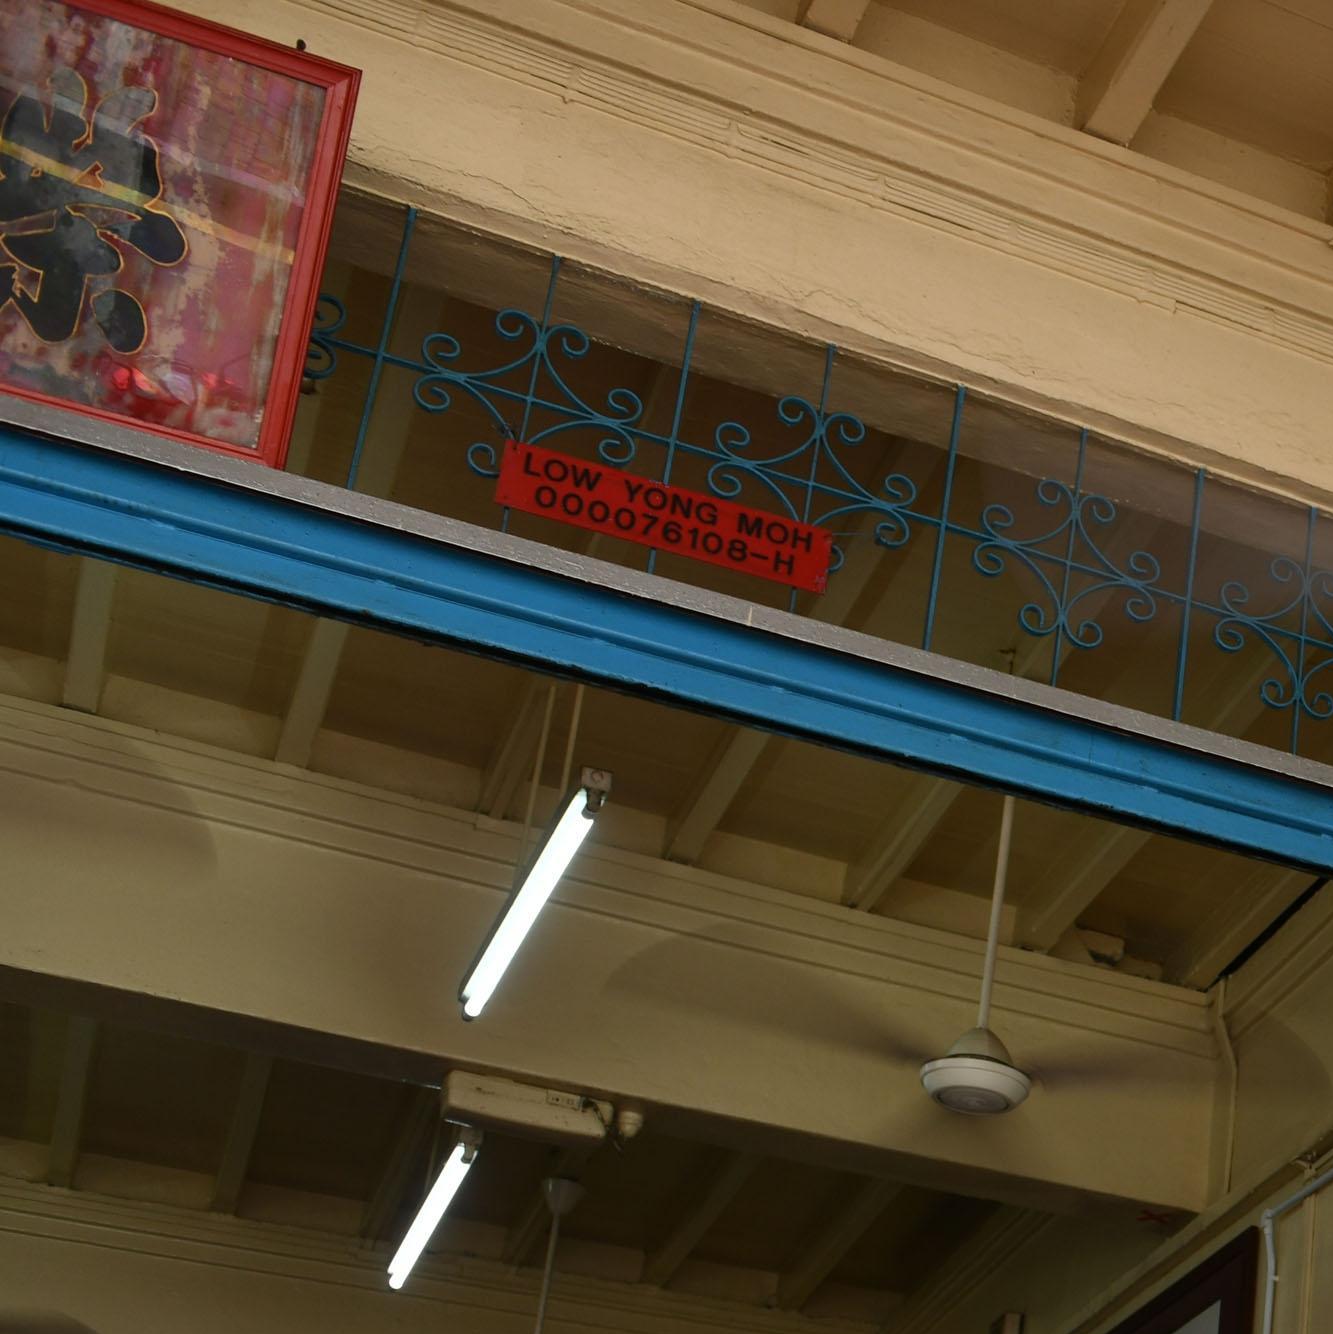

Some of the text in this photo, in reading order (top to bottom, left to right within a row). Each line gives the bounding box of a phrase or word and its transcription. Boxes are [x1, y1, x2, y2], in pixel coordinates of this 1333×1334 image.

[522, 452, 813, 553] LOW YONG MOH
[534, 486, 796, 576] 000076108-H
